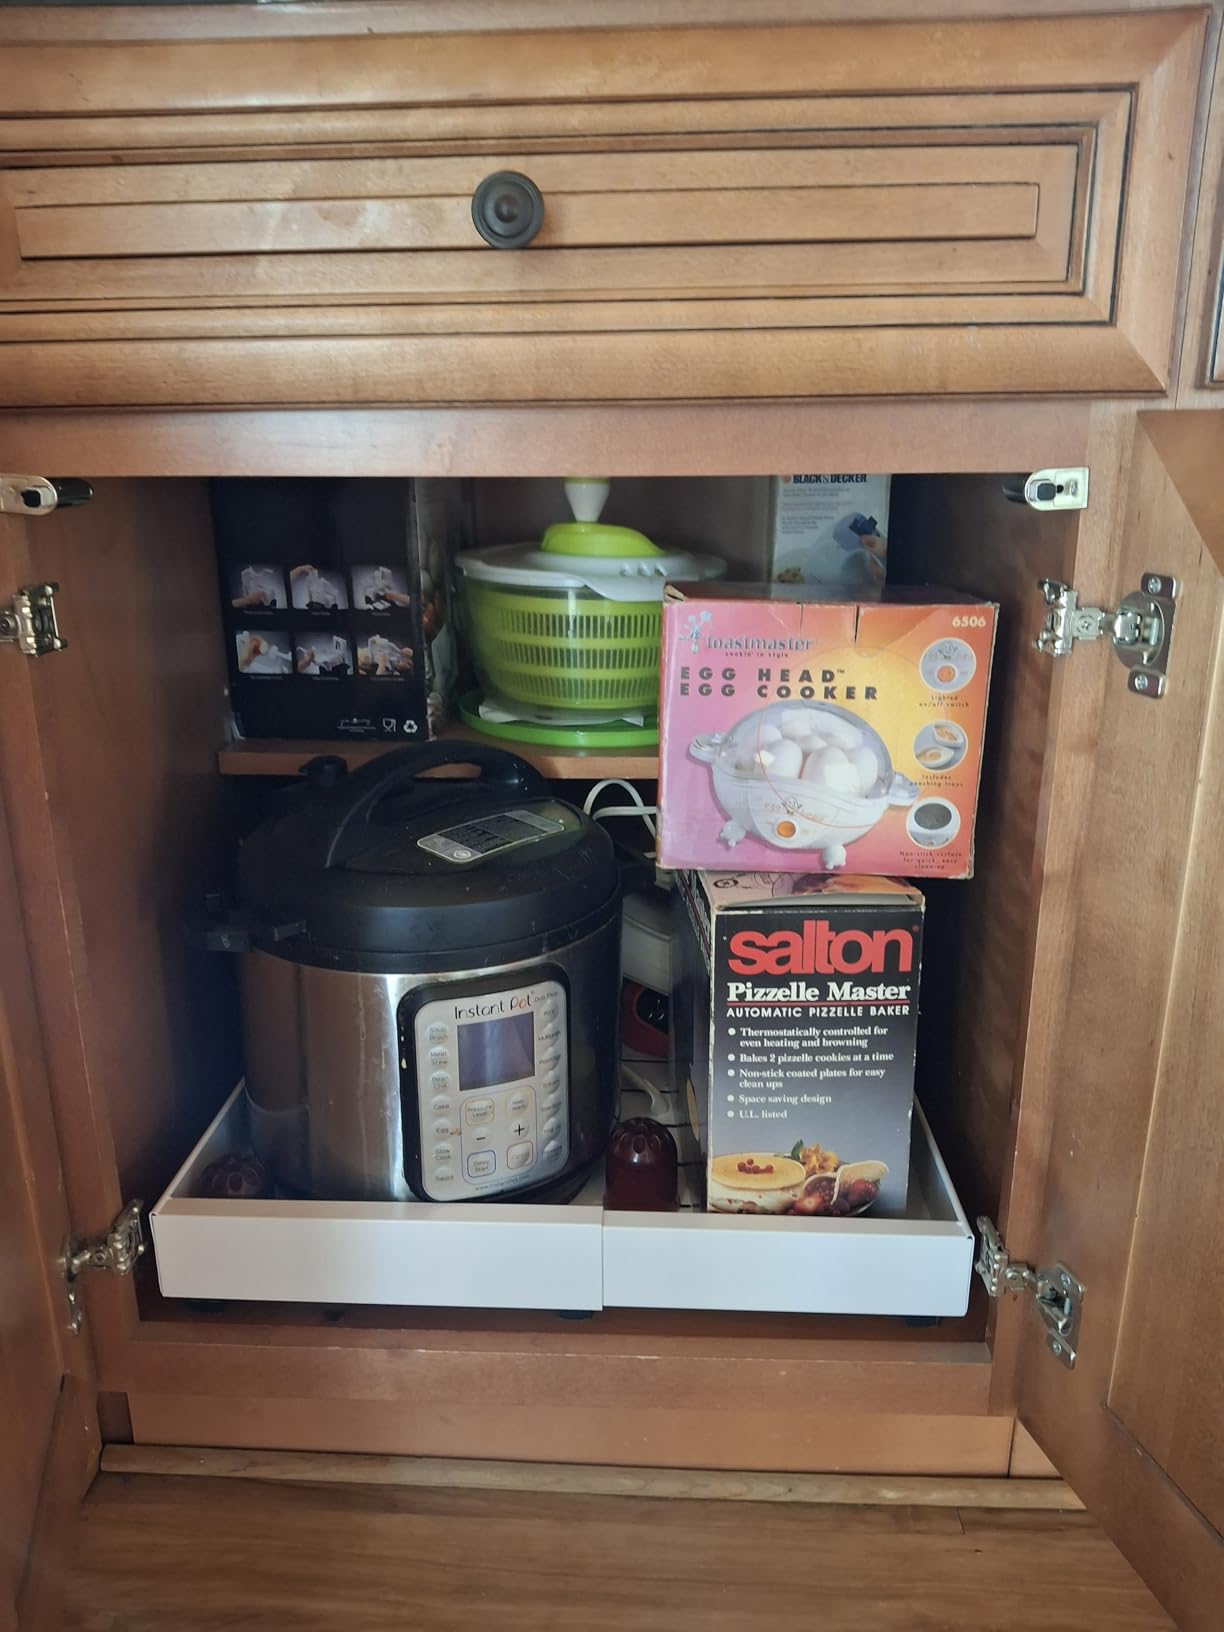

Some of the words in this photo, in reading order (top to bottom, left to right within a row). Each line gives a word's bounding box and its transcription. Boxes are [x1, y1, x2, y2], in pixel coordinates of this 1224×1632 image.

[952, 615, 986, 628] 6506
[680, 667, 736, 680] EGG
[680, 683, 736, 697] EGG
[757, 685, 877, 700] COOKER
[727, 919, 913, 976] salton
[727, 981, 820, 1002] Pizzelle
[827, 981, 912, 1001] Master
[454, 1000, 505, 1020] Instant
[510, 993, 532, 1011] Pot
[726, 1007, 802, 1018] AUTOMATIC
[809, 1006, 863, 1017] PIZZELLE
[870, 1005, 910, 1016] BAKER
[740, 1027, 821, 1038] Thermostatically
[822, 1026, 871, 1036] controlled
[874, 1026, 888, 1035] for
[740, 1039, 761, 1047] even
[763, 1038, 800, 1049] heating
[802, 1038, 820, 1047] and
[822, 1037, 868, 1048] browning
[739, 1053, 767, 1063] Bakes
[769, 1054, 776, 1063] 2
[777, 1053, 813, 1065] pizzelle
[815, 1052, 851, 1062] cookies
[852, 1053, 862, 1062] at
[863, 1054, 870, 1062] a
[871, 1052, 894, 1061] time
[739, 1069, 785, 1078] Non-stick
[786, 1068, 818, 1078] coated
[819, 1068, 847, 1080] plates
[849, 1068, 863, 1077] for
[865, 1069, 886, 1078] easy
[739, 1079, 764, 1088] clean
[766, 1080, 783, 1090] ups
[738, 1094, 766, 1105] Space
[767, 1094, 798, 1105] saving
[800, 1093, 832, 1105] design
[739, 1109, 759, 1119] U.L.
[761, 1109, 787, 1119] listed
